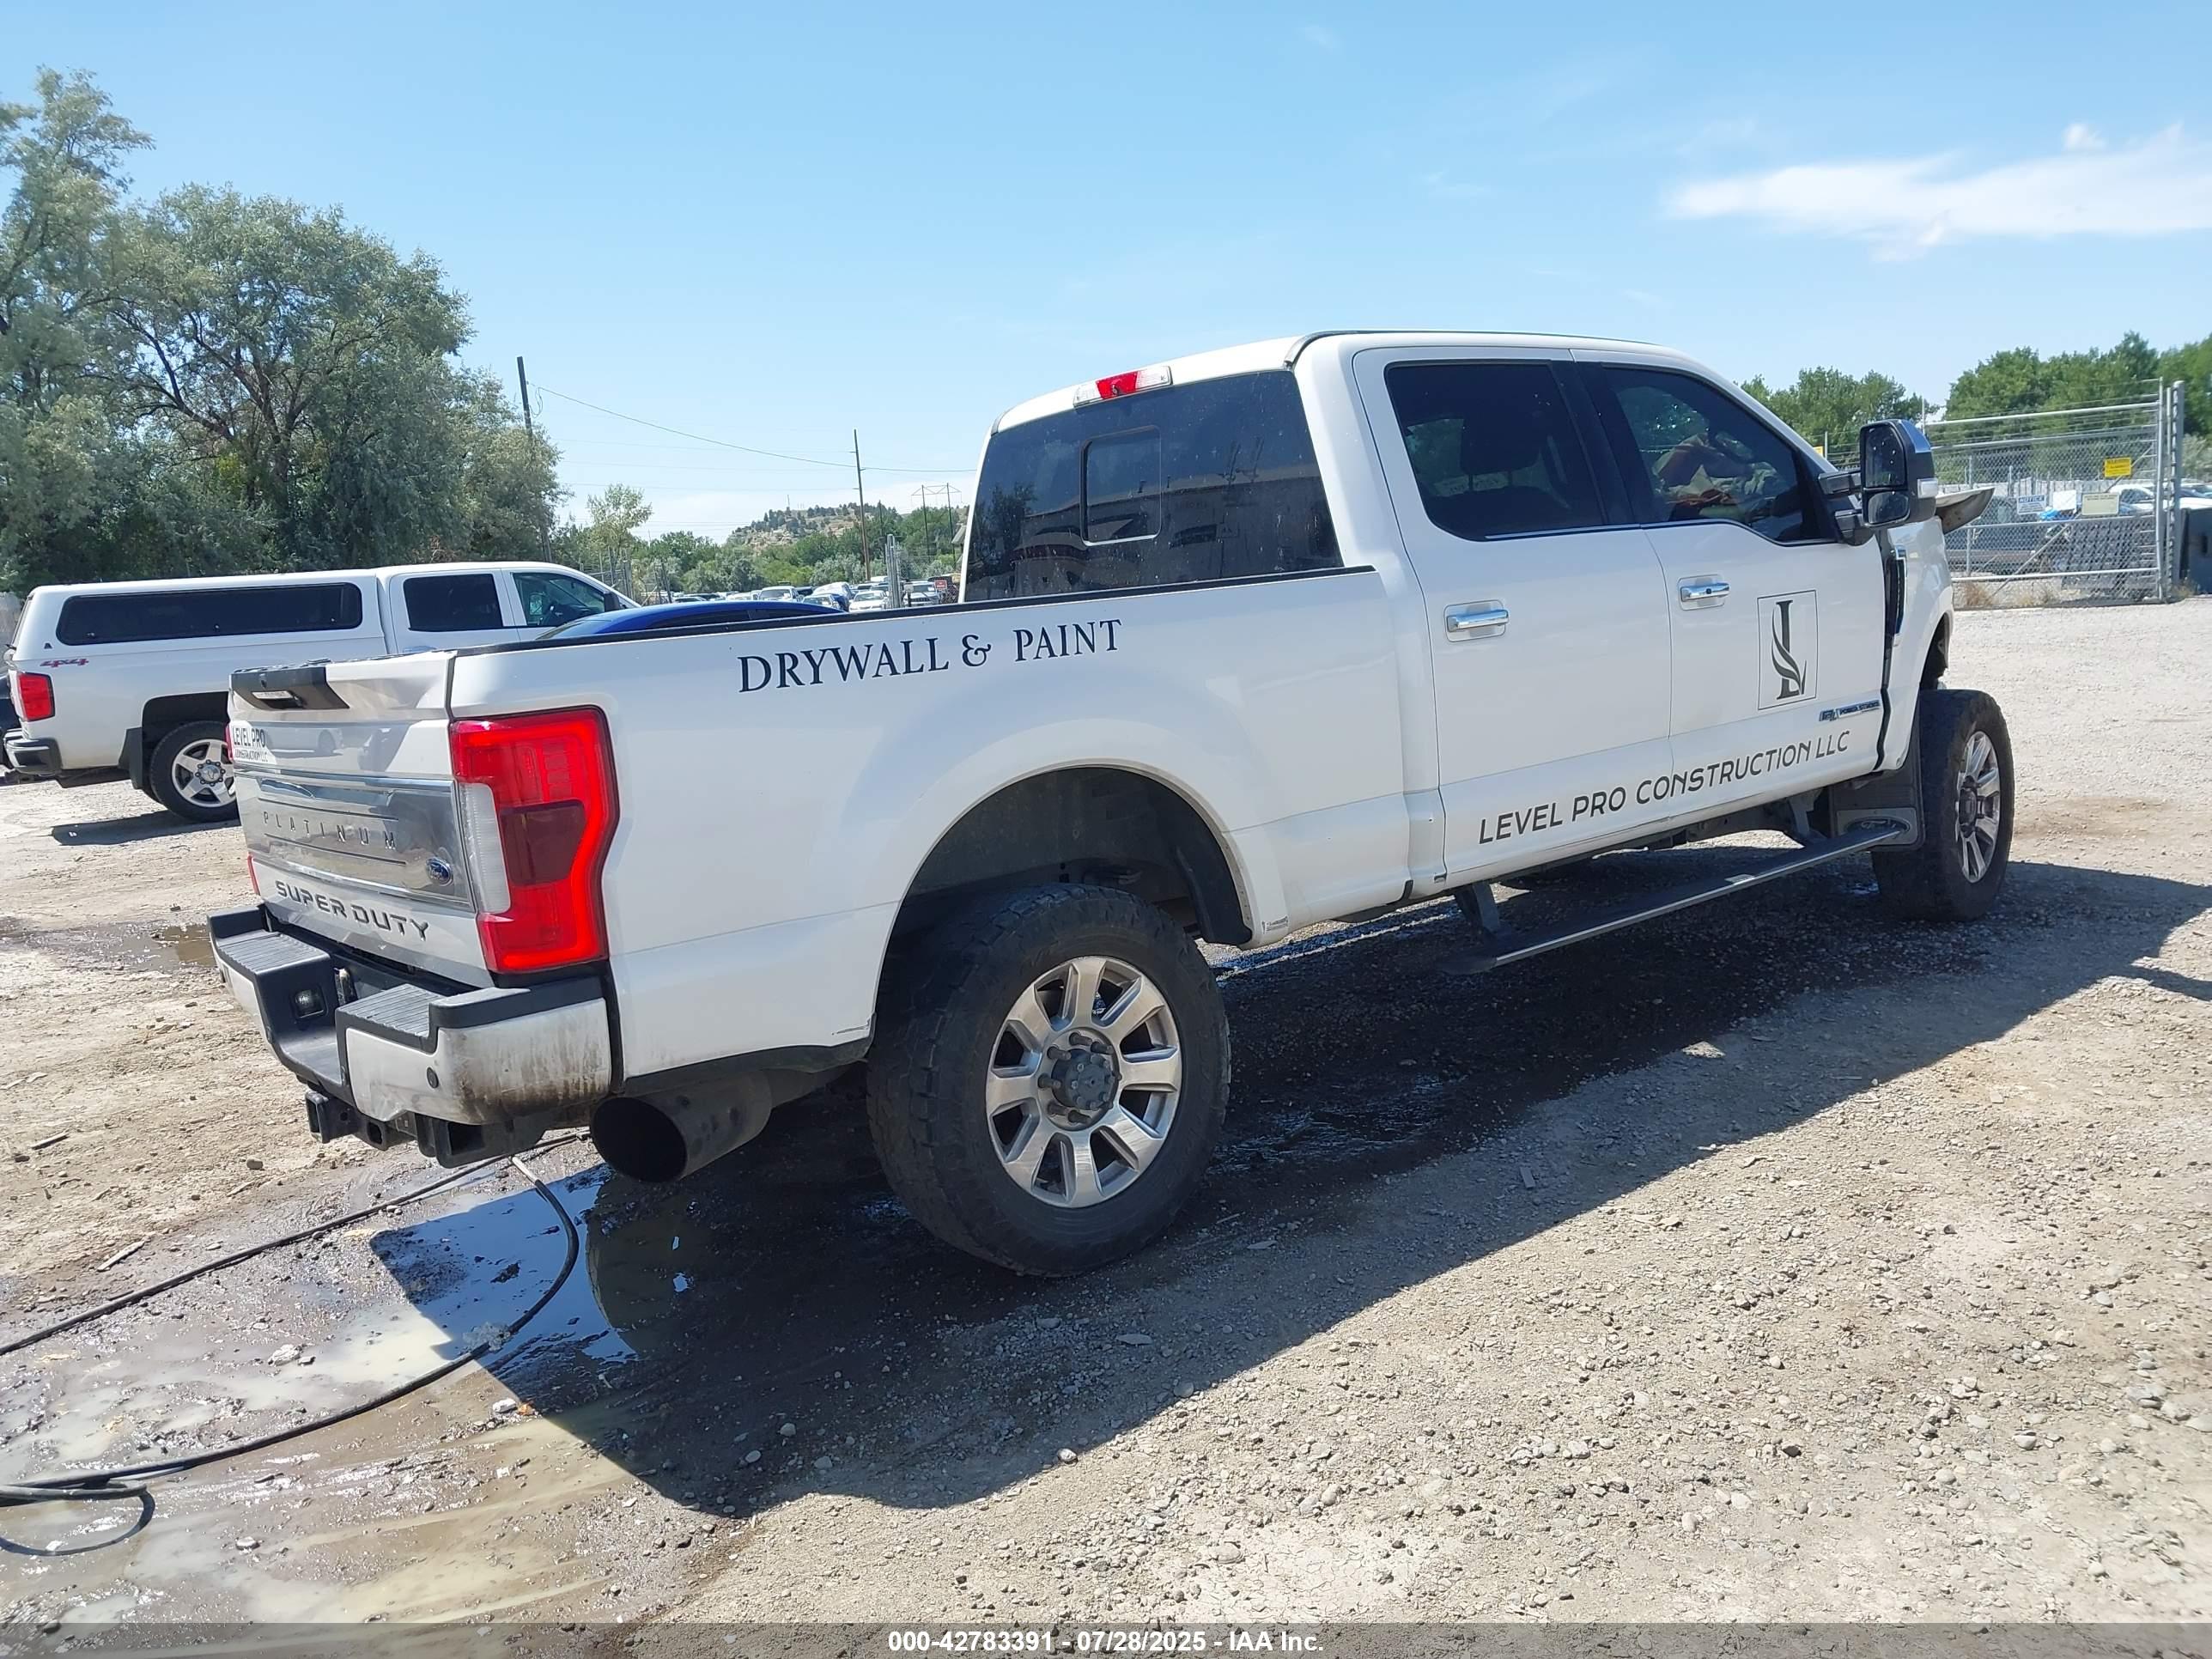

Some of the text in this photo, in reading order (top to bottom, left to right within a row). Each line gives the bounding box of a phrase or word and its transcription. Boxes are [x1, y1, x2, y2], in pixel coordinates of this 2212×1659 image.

[738, 619, 1122, 693] DRYWALL & PAINT
[233, 727, 265, 747] LEVEL PRO
[1479, 730, 1850, 844] LEVEL PRO CONSTRUCTION LLC
[263, 811, 396, 850] PLATINUM
[275, 879, 429, 941] SUPER DUTY
